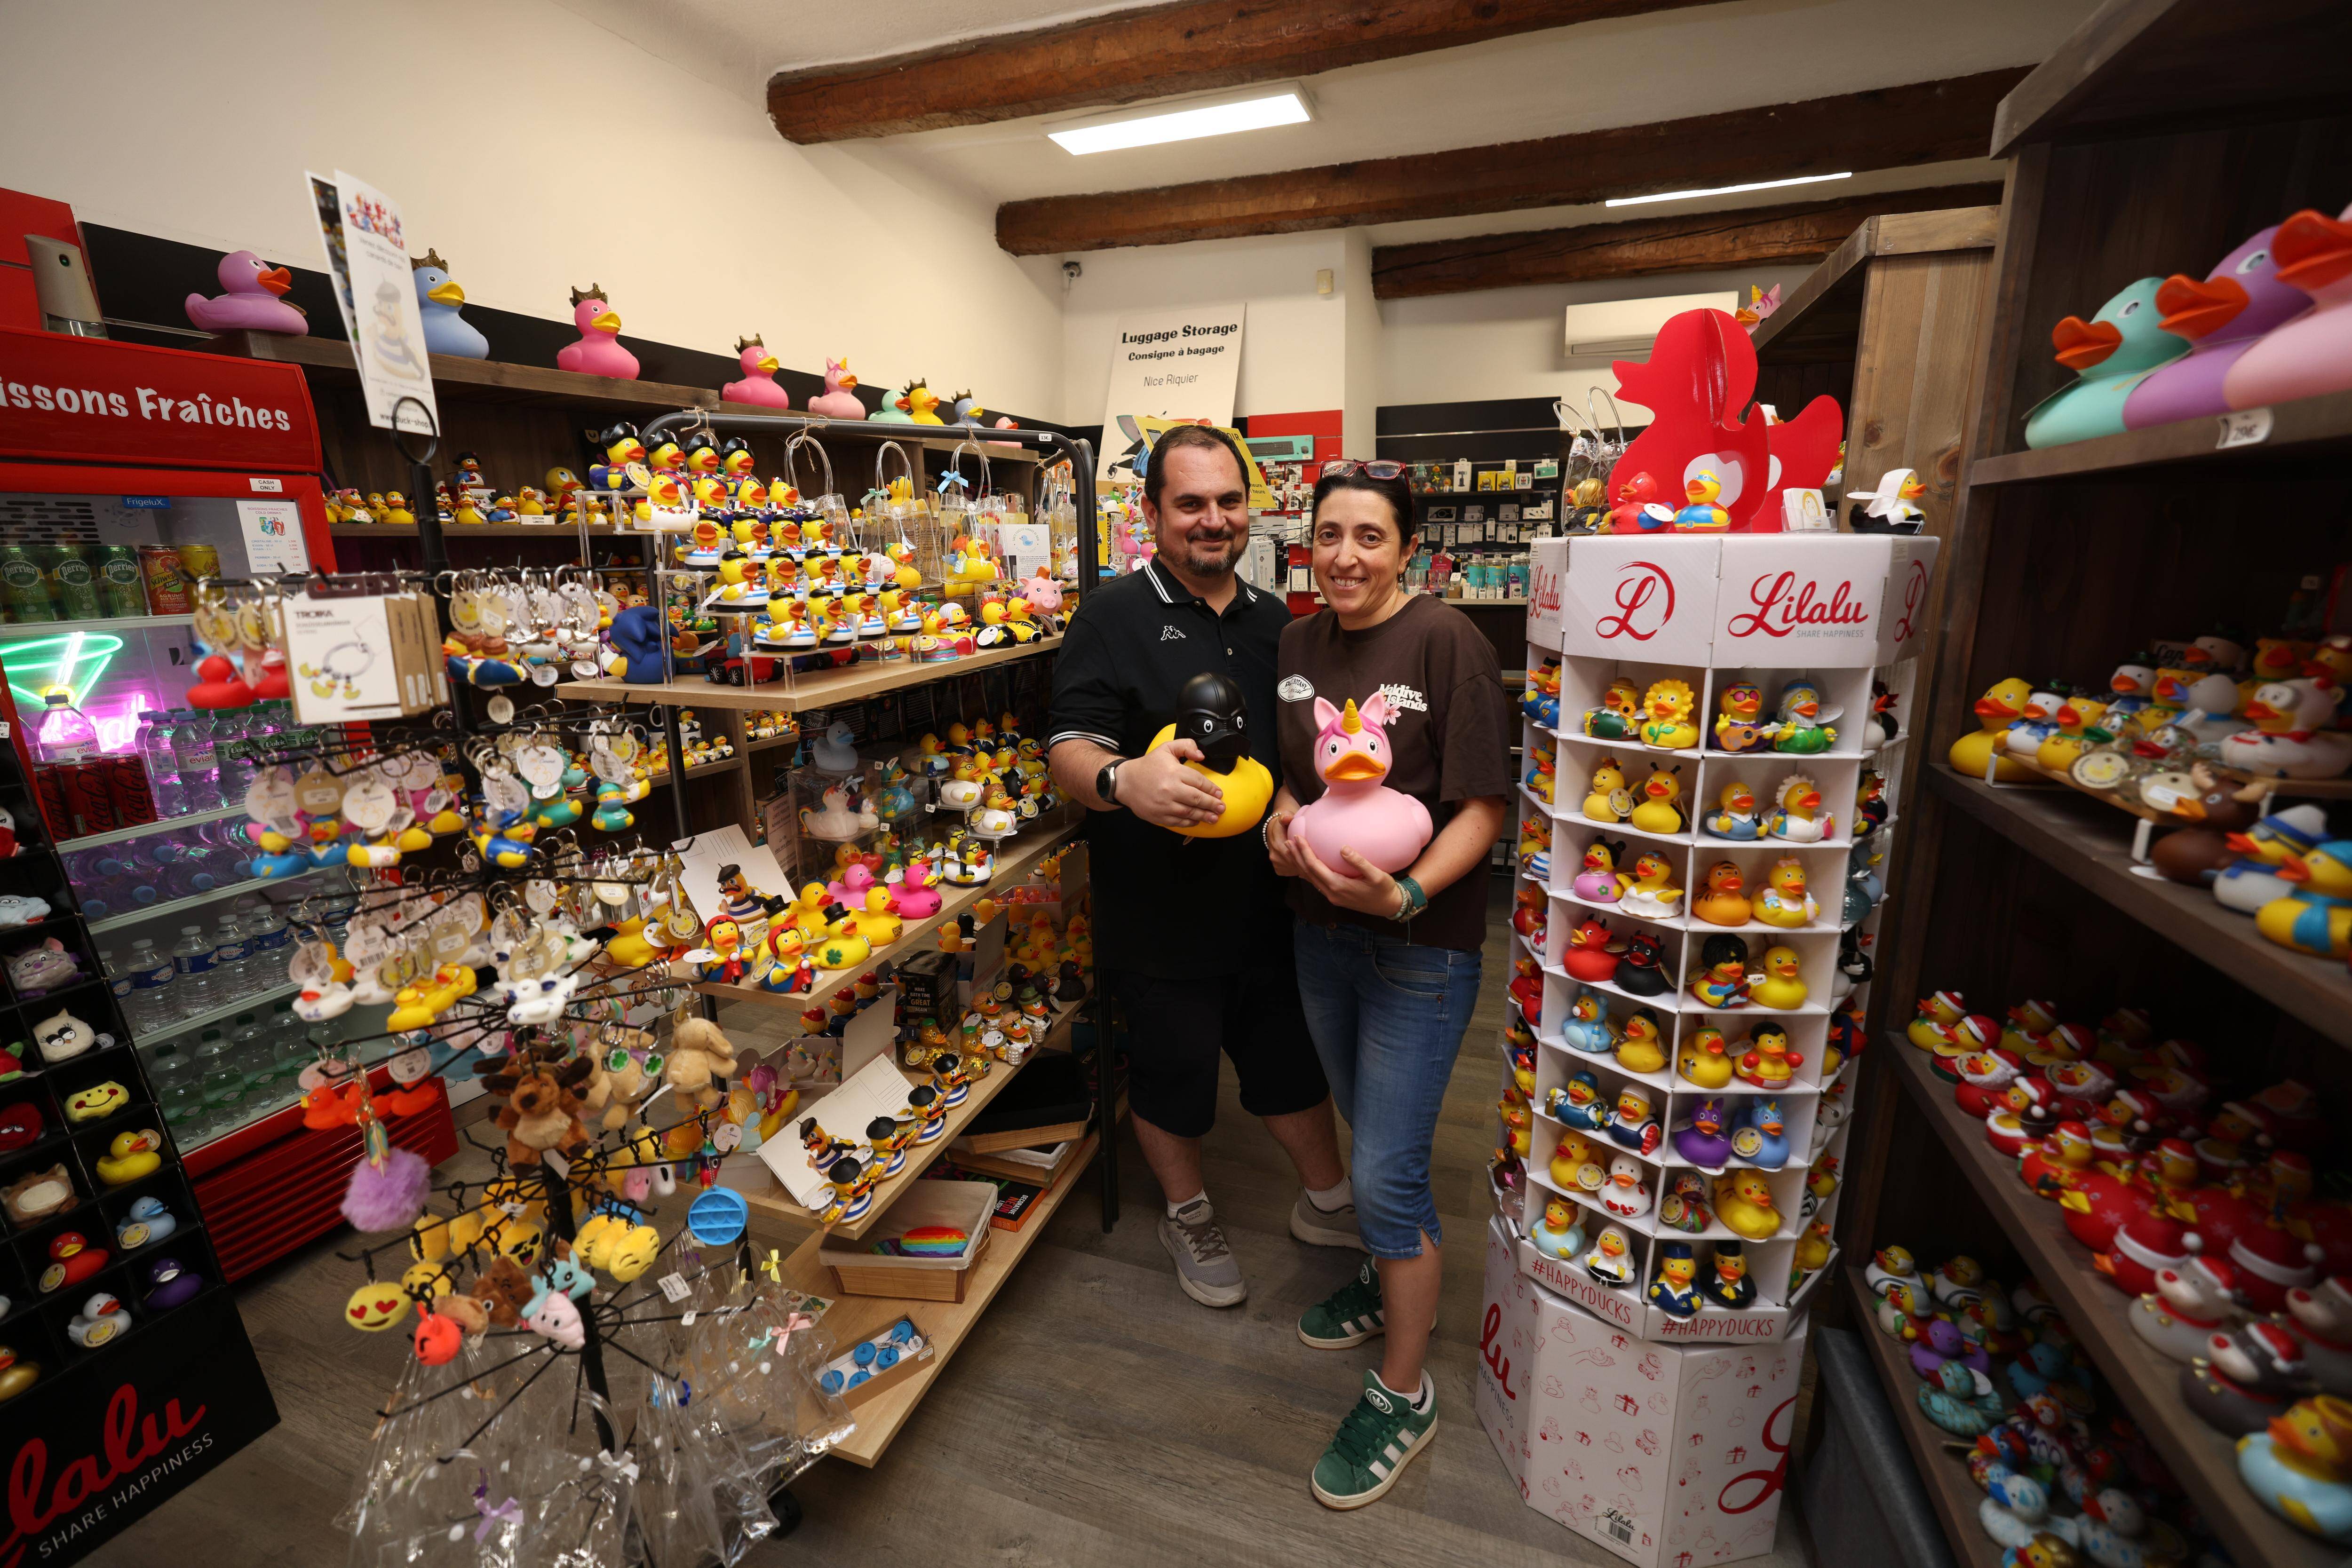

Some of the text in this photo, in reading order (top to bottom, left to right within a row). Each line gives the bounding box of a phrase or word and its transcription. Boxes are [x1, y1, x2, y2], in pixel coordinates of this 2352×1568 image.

[1122, 324, 1238, 344] Luggage Storage
[1128, 350, 1175, 361] Consigne
[1187, 345, 1224, 356] bagage
[1144, 374, 1199, 387] Nice Riquier
[135, 387, 291, 431] Fraîches
[151, 572, 176, 586] Schwep
[1530, 564, 1561, 619] Lilalu
[1728, 571, 1868, 638] Lilalu
[1823, 630, 1864, 638] HAPPINESS
[1293, 678, 1308, 689] BOTANY
[1380, 684, 1422, 701] Maldive
[1387, 696, 1427, 712] Islands
[77, 744, 98, 754] evian
[230, 743, 252, 755] Volvic
[266, 739, 286, 749] Volvic
[190, 754, 215, 764] evian
[994, 1200, 1005, 1211] LIGHT
[998, 1196, 1019, 1213] NEON
[1008, 1195, 1029, 1215] DECORATIVE
[1531, 1259, 1630, 1324] #HAPPYDUCKS
[1661, 1318, 1774, 1338] #HAPPYDUCKS
[39, 1433, 214, 1559] SHARE HAPPINESS
[1602, 1507, 1636, 1531] Lilalu
